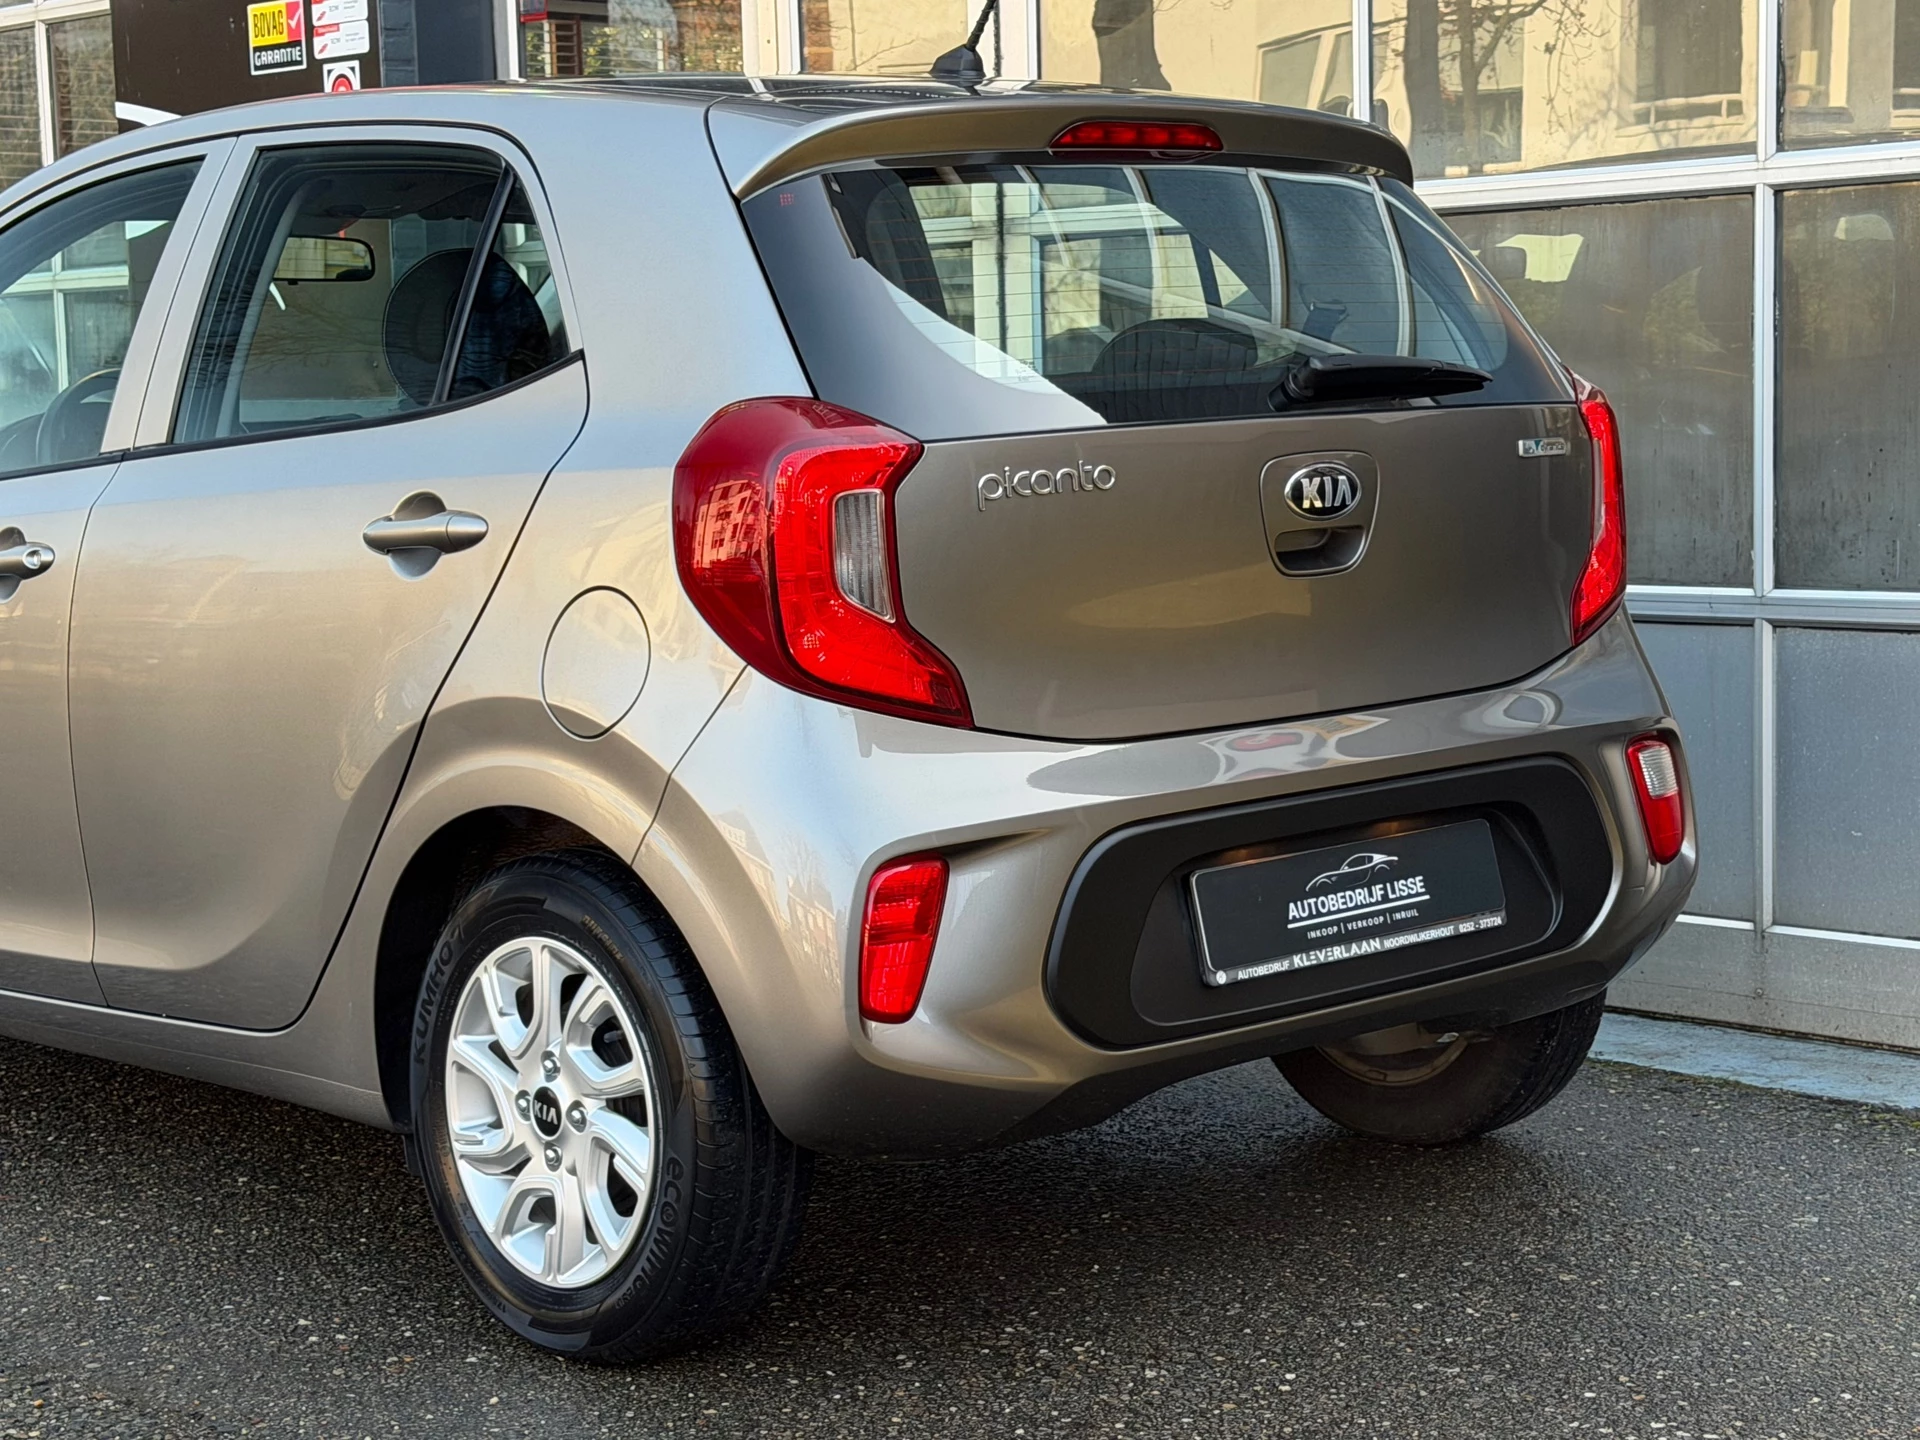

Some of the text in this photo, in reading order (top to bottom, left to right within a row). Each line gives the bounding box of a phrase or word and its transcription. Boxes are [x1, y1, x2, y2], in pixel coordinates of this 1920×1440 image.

[254, 10, 284, 38] BOVAG
[254, 46, 302, 66] GARANTIE
[979, 460, 1116, 511] picanto
[1301, 475, 1352, 508] KIA
[1288, 876, 1426, 920] AUTOBEDRIJF LISSE
[1307, 909, 1419, 940] INKOOP VERKOOP INRUIL
[1237, 960, 1290, 981] AUTOBEDRIJF
[1293, 937, 1381, 968] KLEVERLAAN
[1383, 925, 1455, 948] NOORDWIJKERHOUT
[414, 940, 453, 1065] KUMHO
[534, 1100, 558, 1125] KIA
